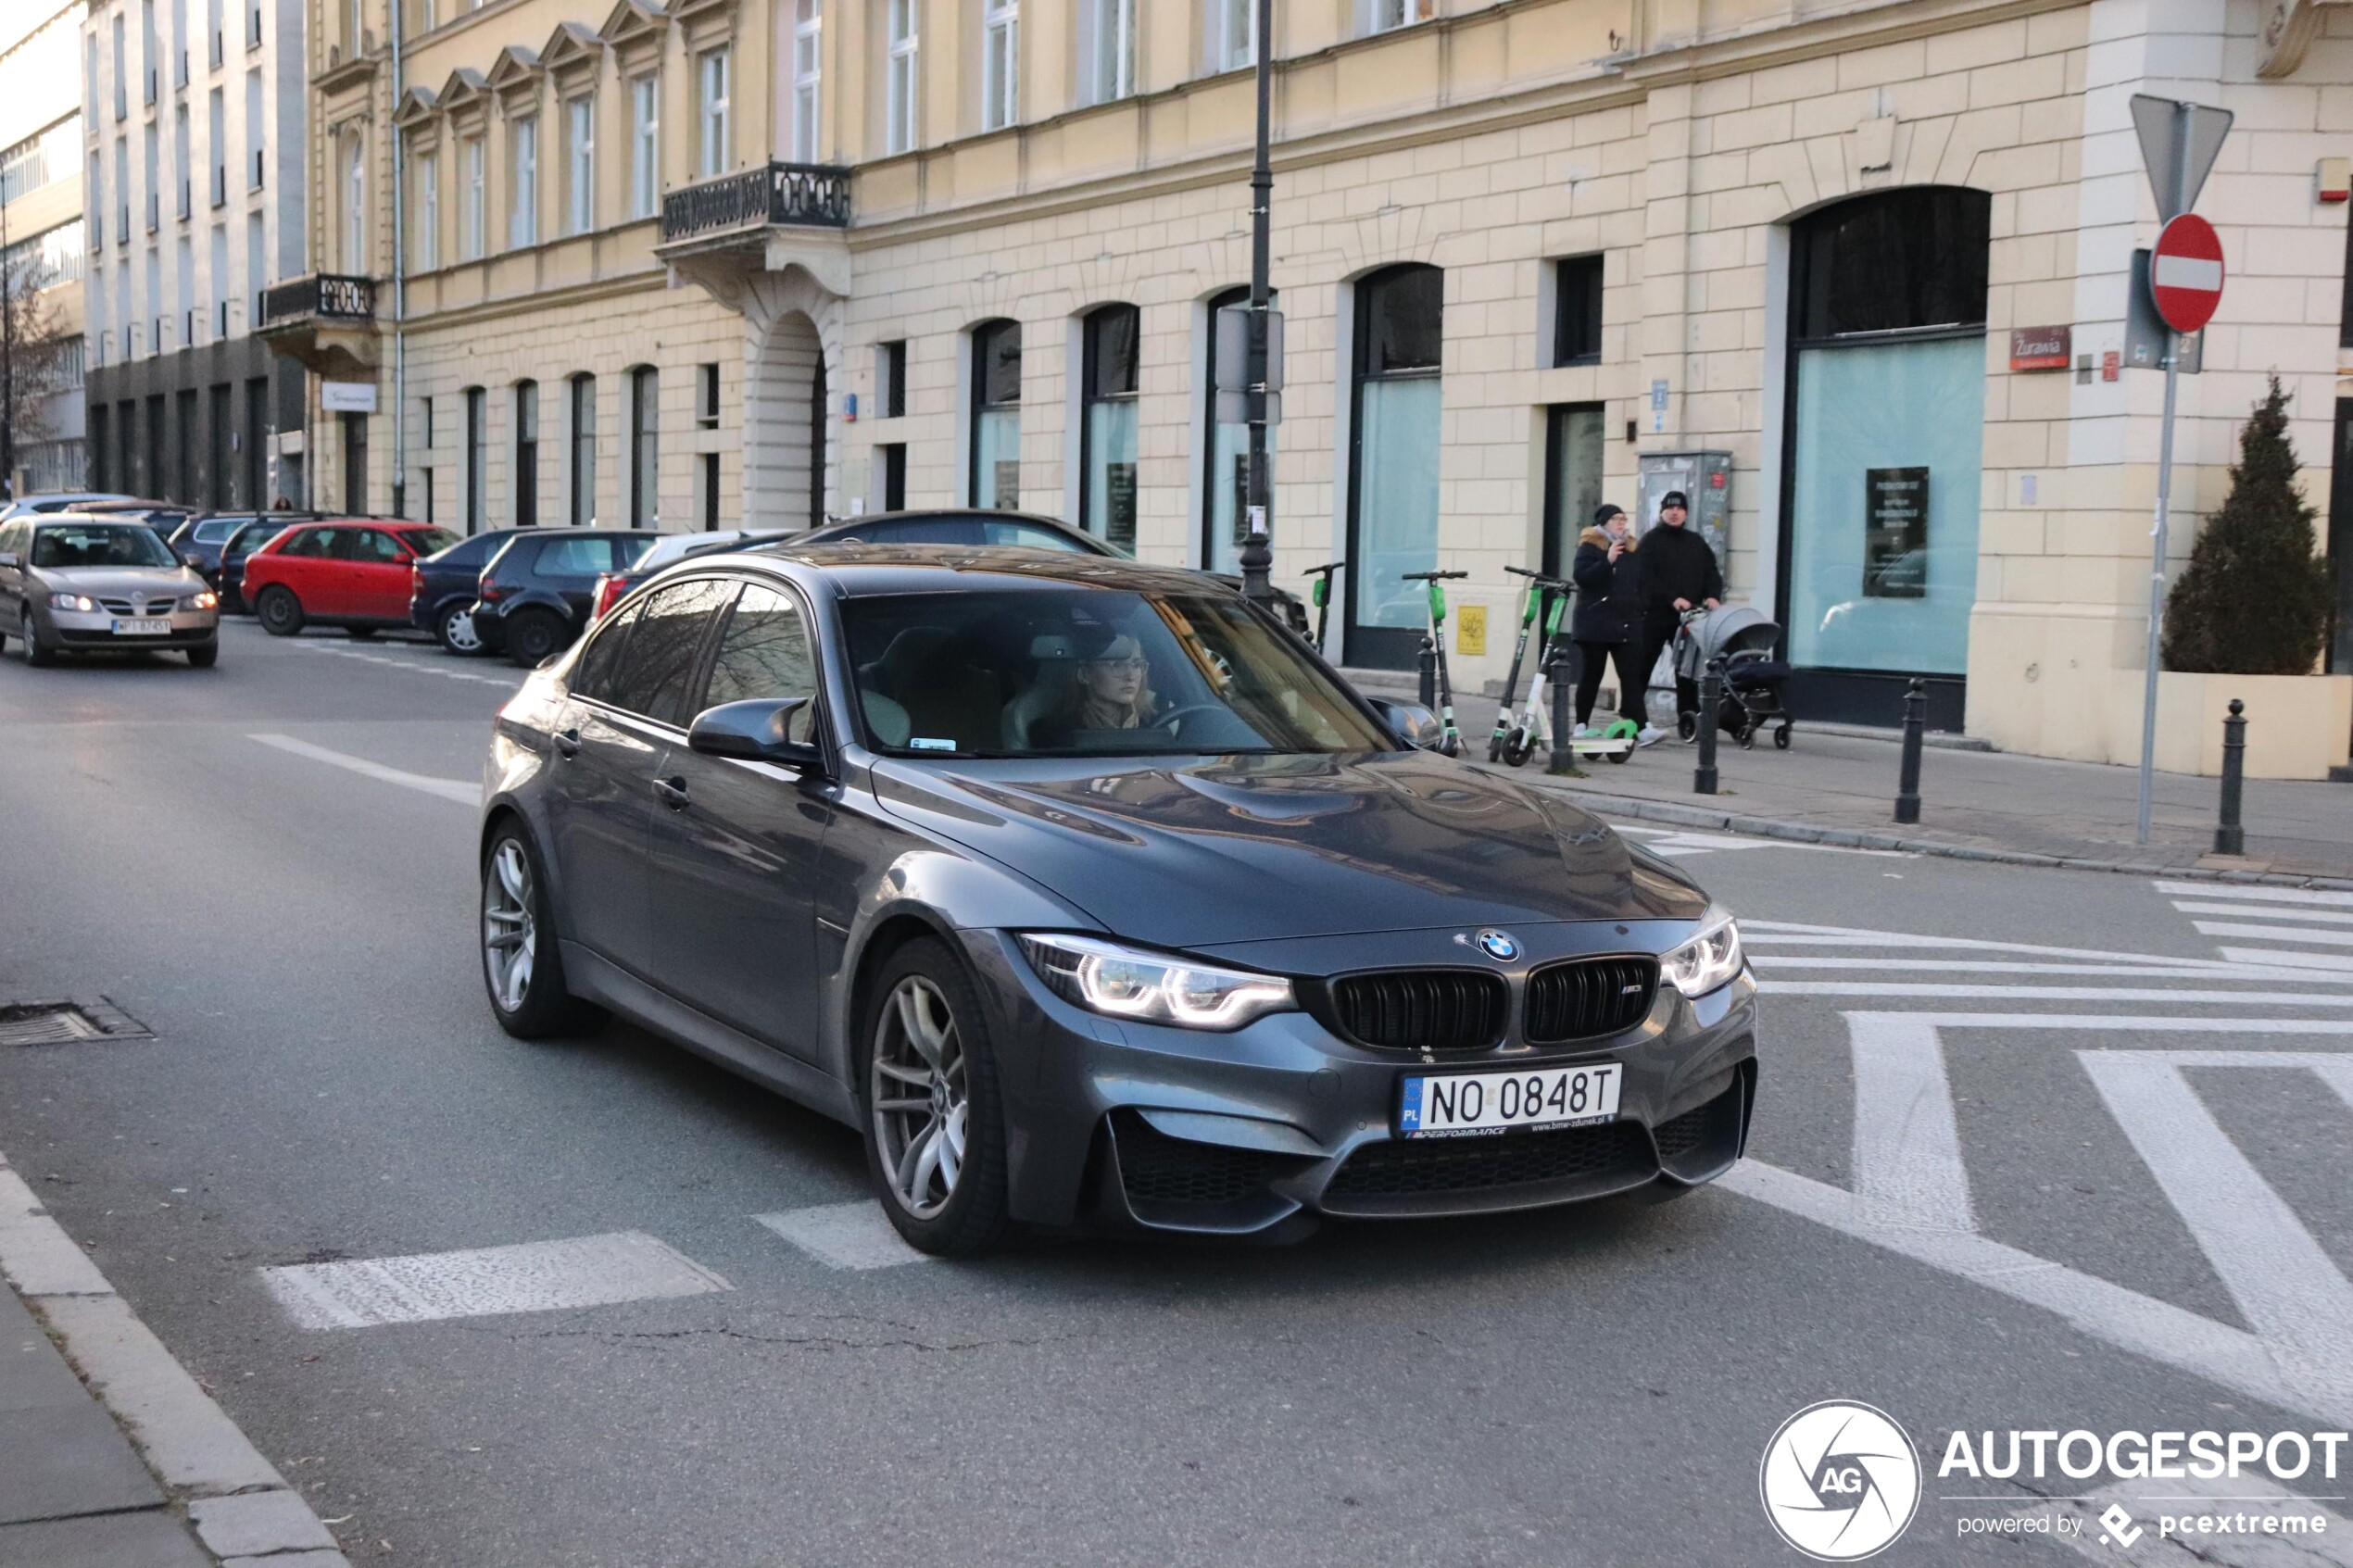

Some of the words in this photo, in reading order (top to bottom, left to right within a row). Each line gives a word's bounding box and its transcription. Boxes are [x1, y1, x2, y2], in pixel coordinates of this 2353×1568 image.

[1430, 1079, 1484, 1124] NO
[1500, 1069, 1613, 1120] 0848T
[1403, 1109, 1419, 1122] PL
[1531, 1114, 1605, 1133] www.bmw-zdunek.pl
